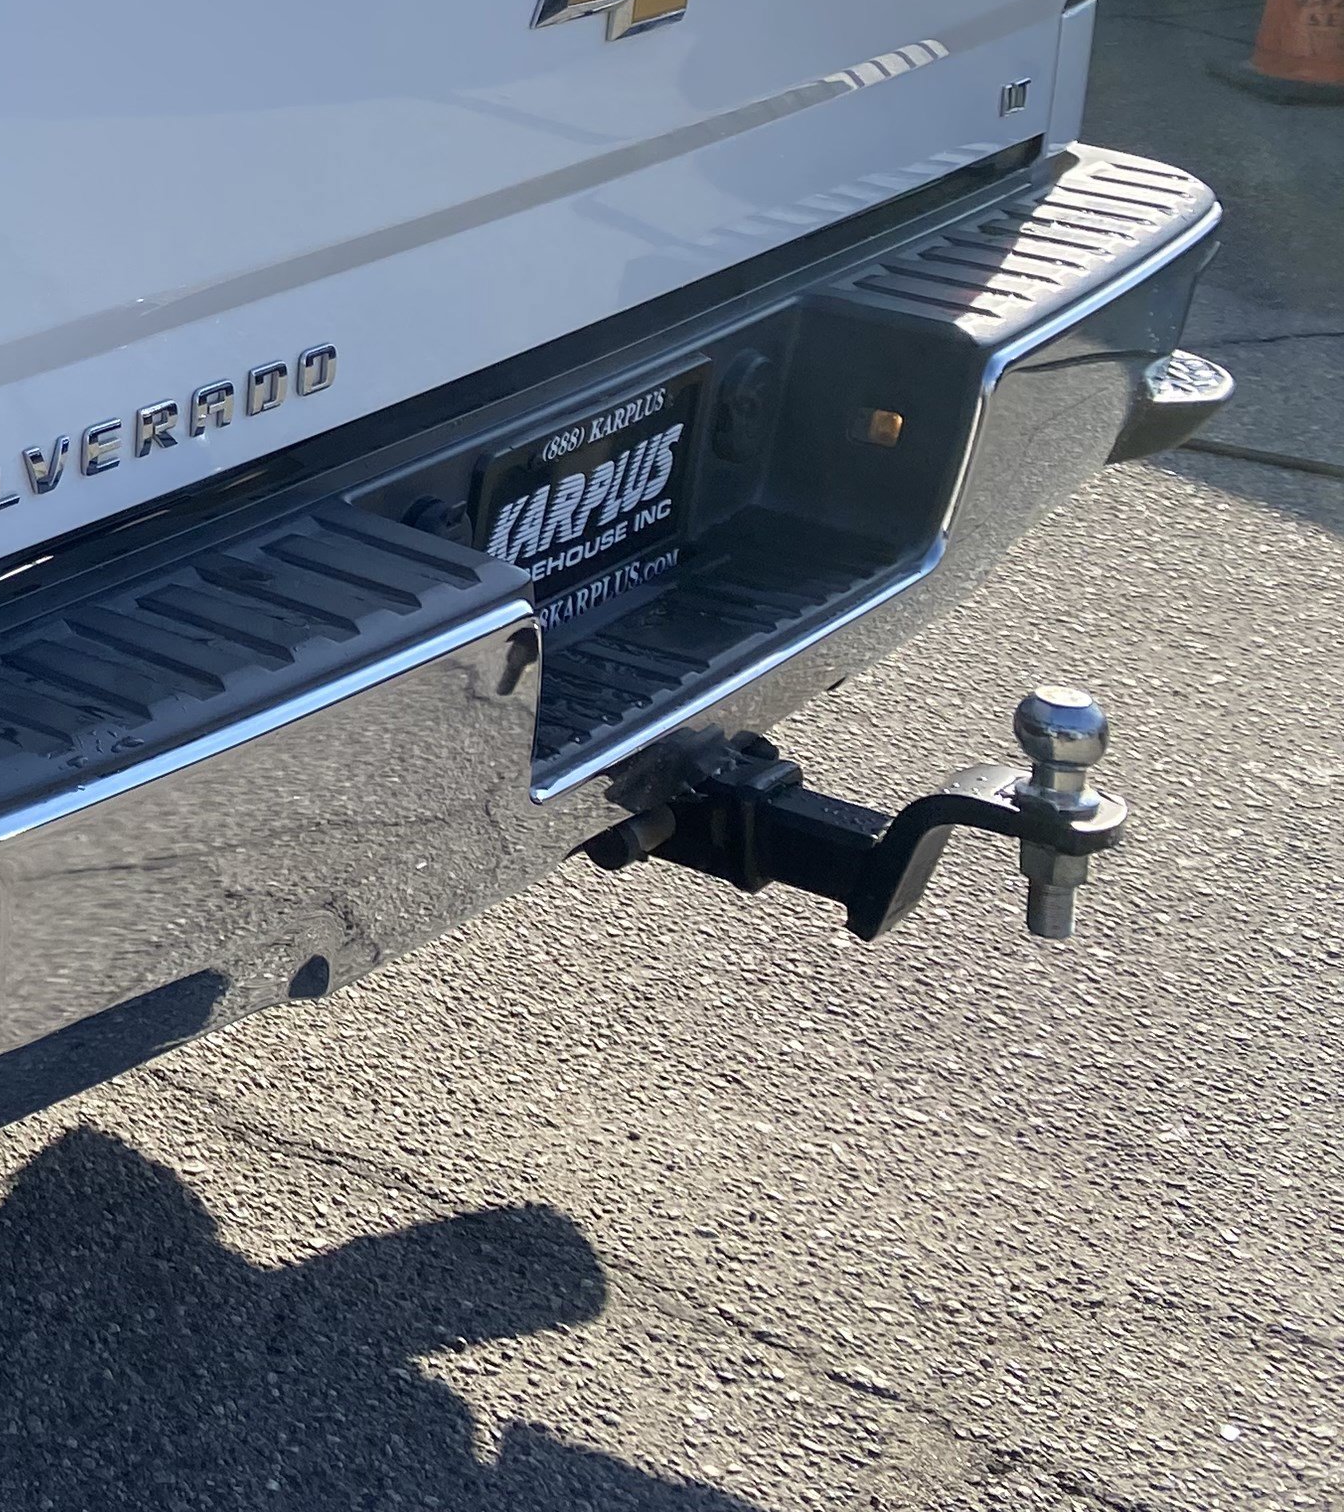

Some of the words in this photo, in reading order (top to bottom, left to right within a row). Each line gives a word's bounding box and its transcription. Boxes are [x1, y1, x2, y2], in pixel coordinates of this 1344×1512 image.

[541, 426, 586, 463] (888)
[587, 387, 666, 445] KARPLUS
[486, 422, 685, 566] KARPLUS
[633, 498, 673, 532] INC
